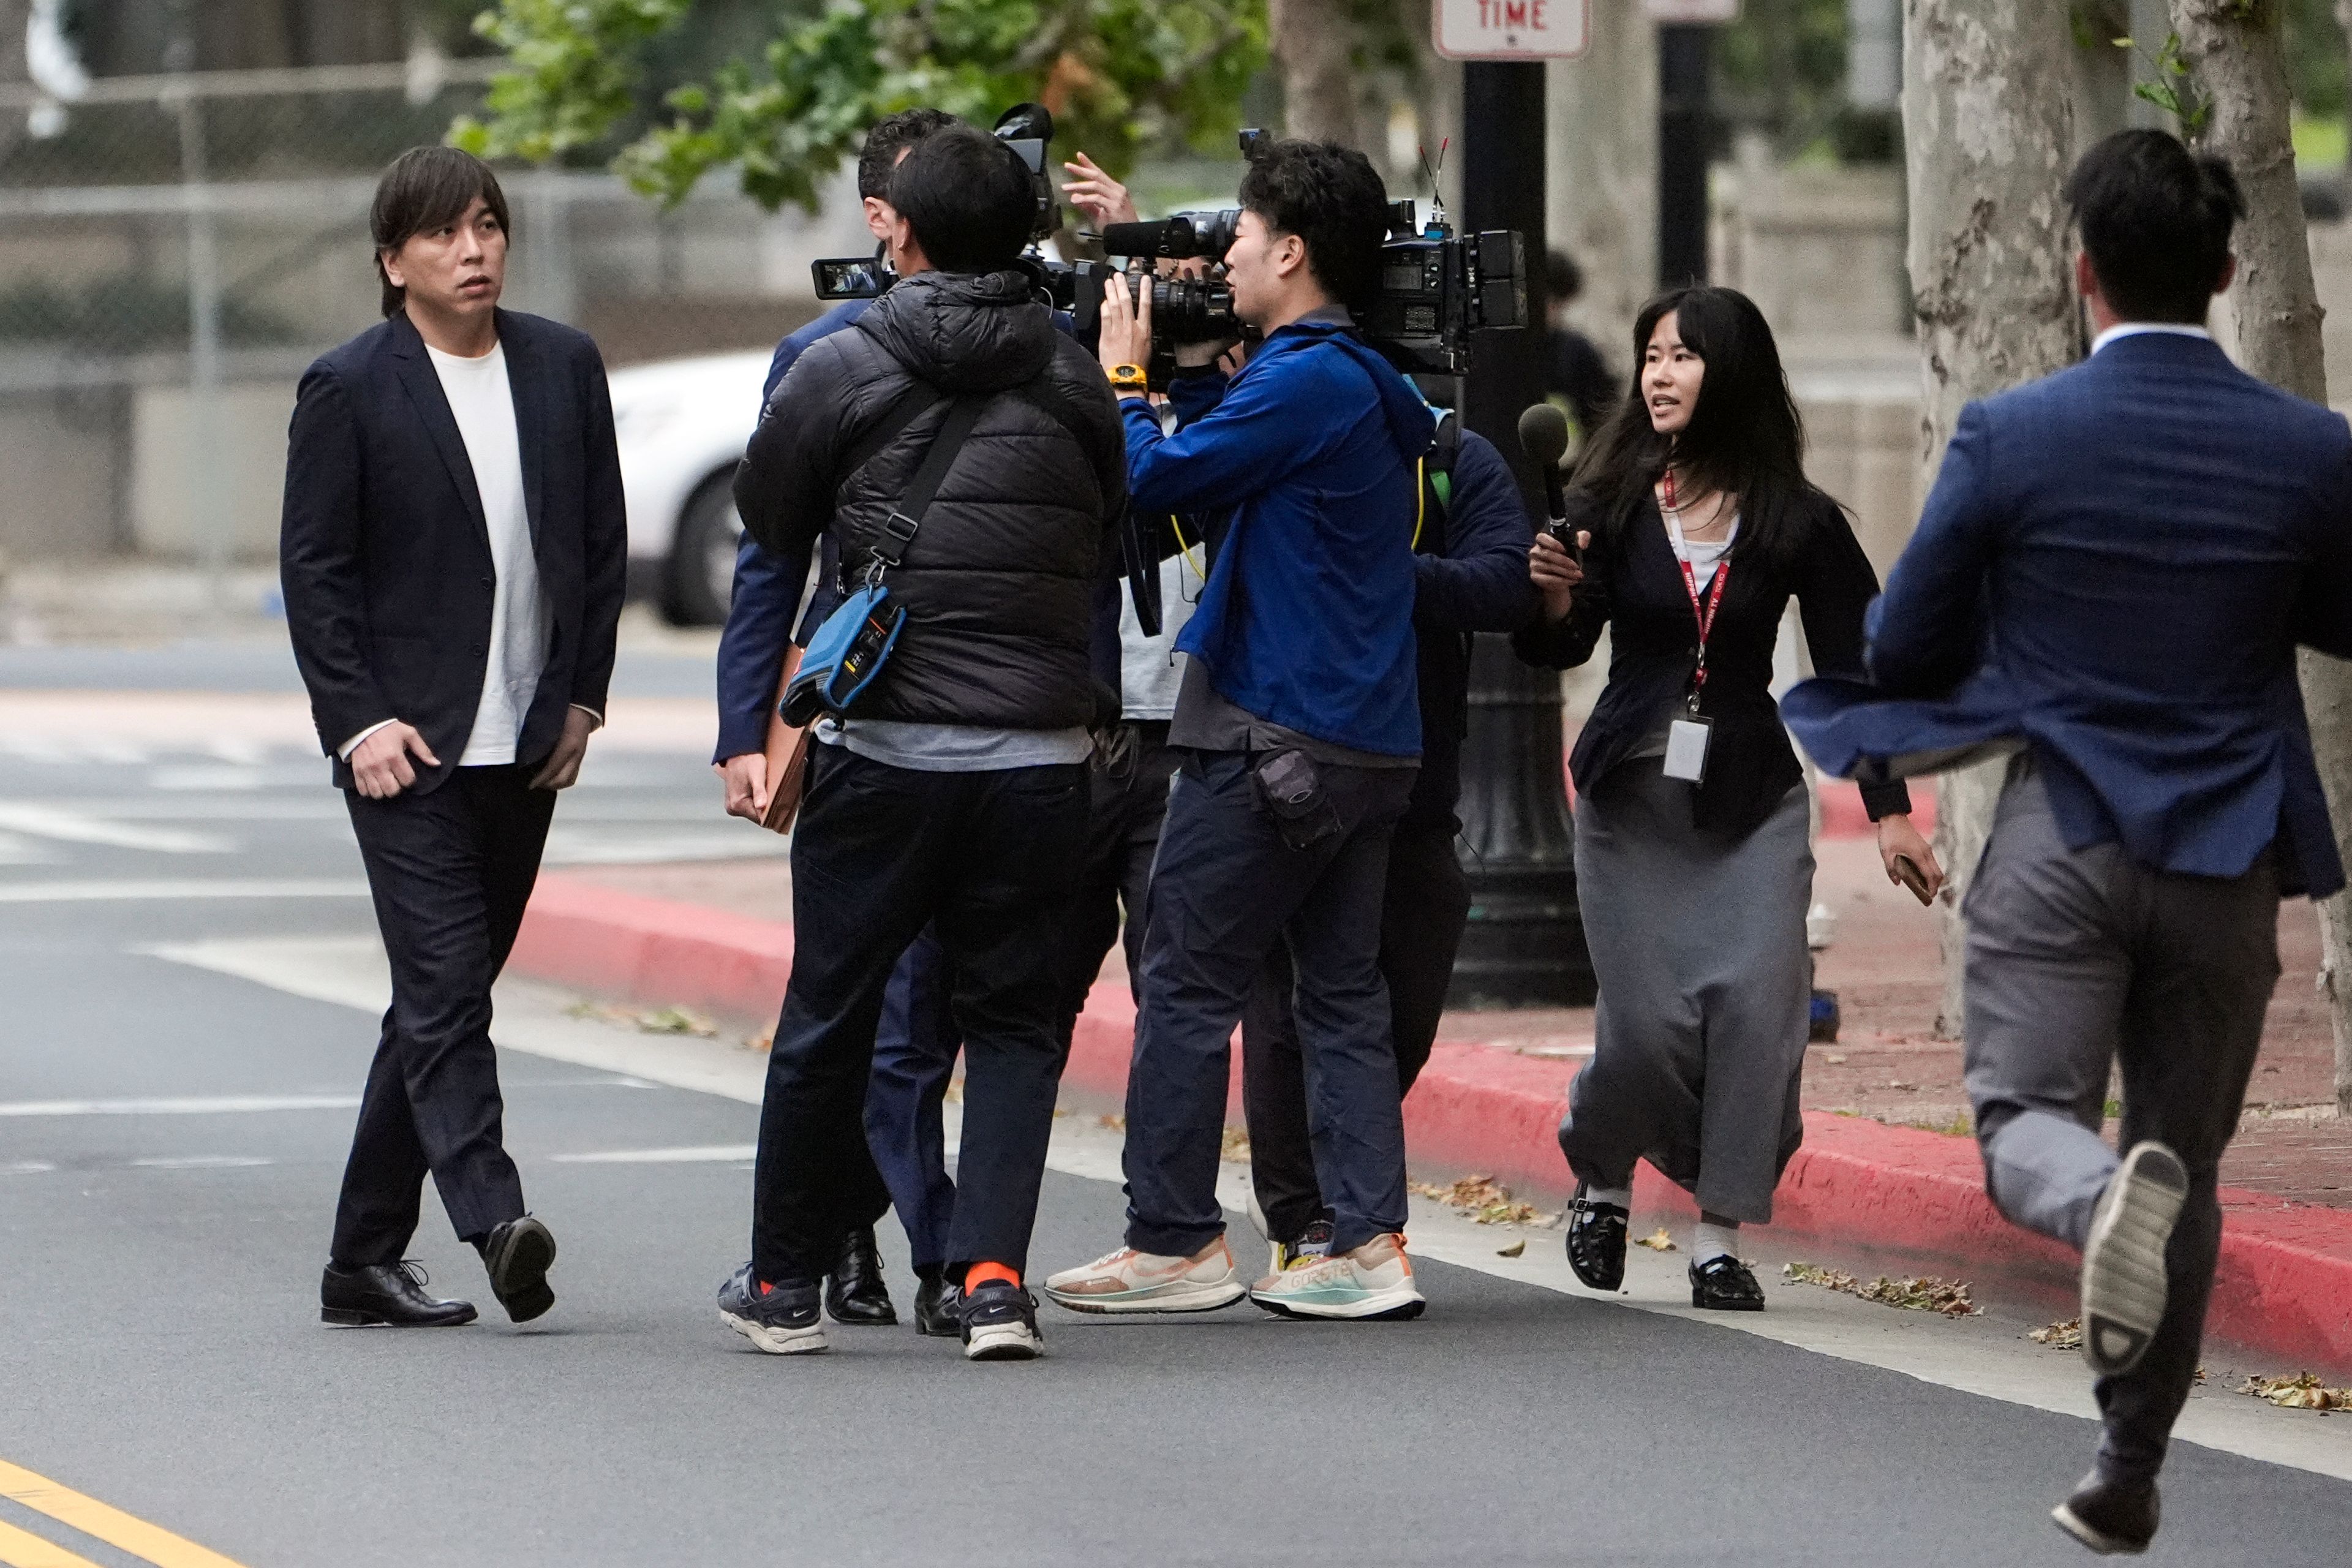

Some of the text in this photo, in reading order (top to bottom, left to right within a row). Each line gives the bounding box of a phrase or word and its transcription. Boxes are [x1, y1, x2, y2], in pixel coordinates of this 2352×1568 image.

[1476, 0, 1548, 30] TIME
[1685, 571, 1697, 597] NIPPON
[1705, 573, 1725, 634] NIPPON TV TOKYO
